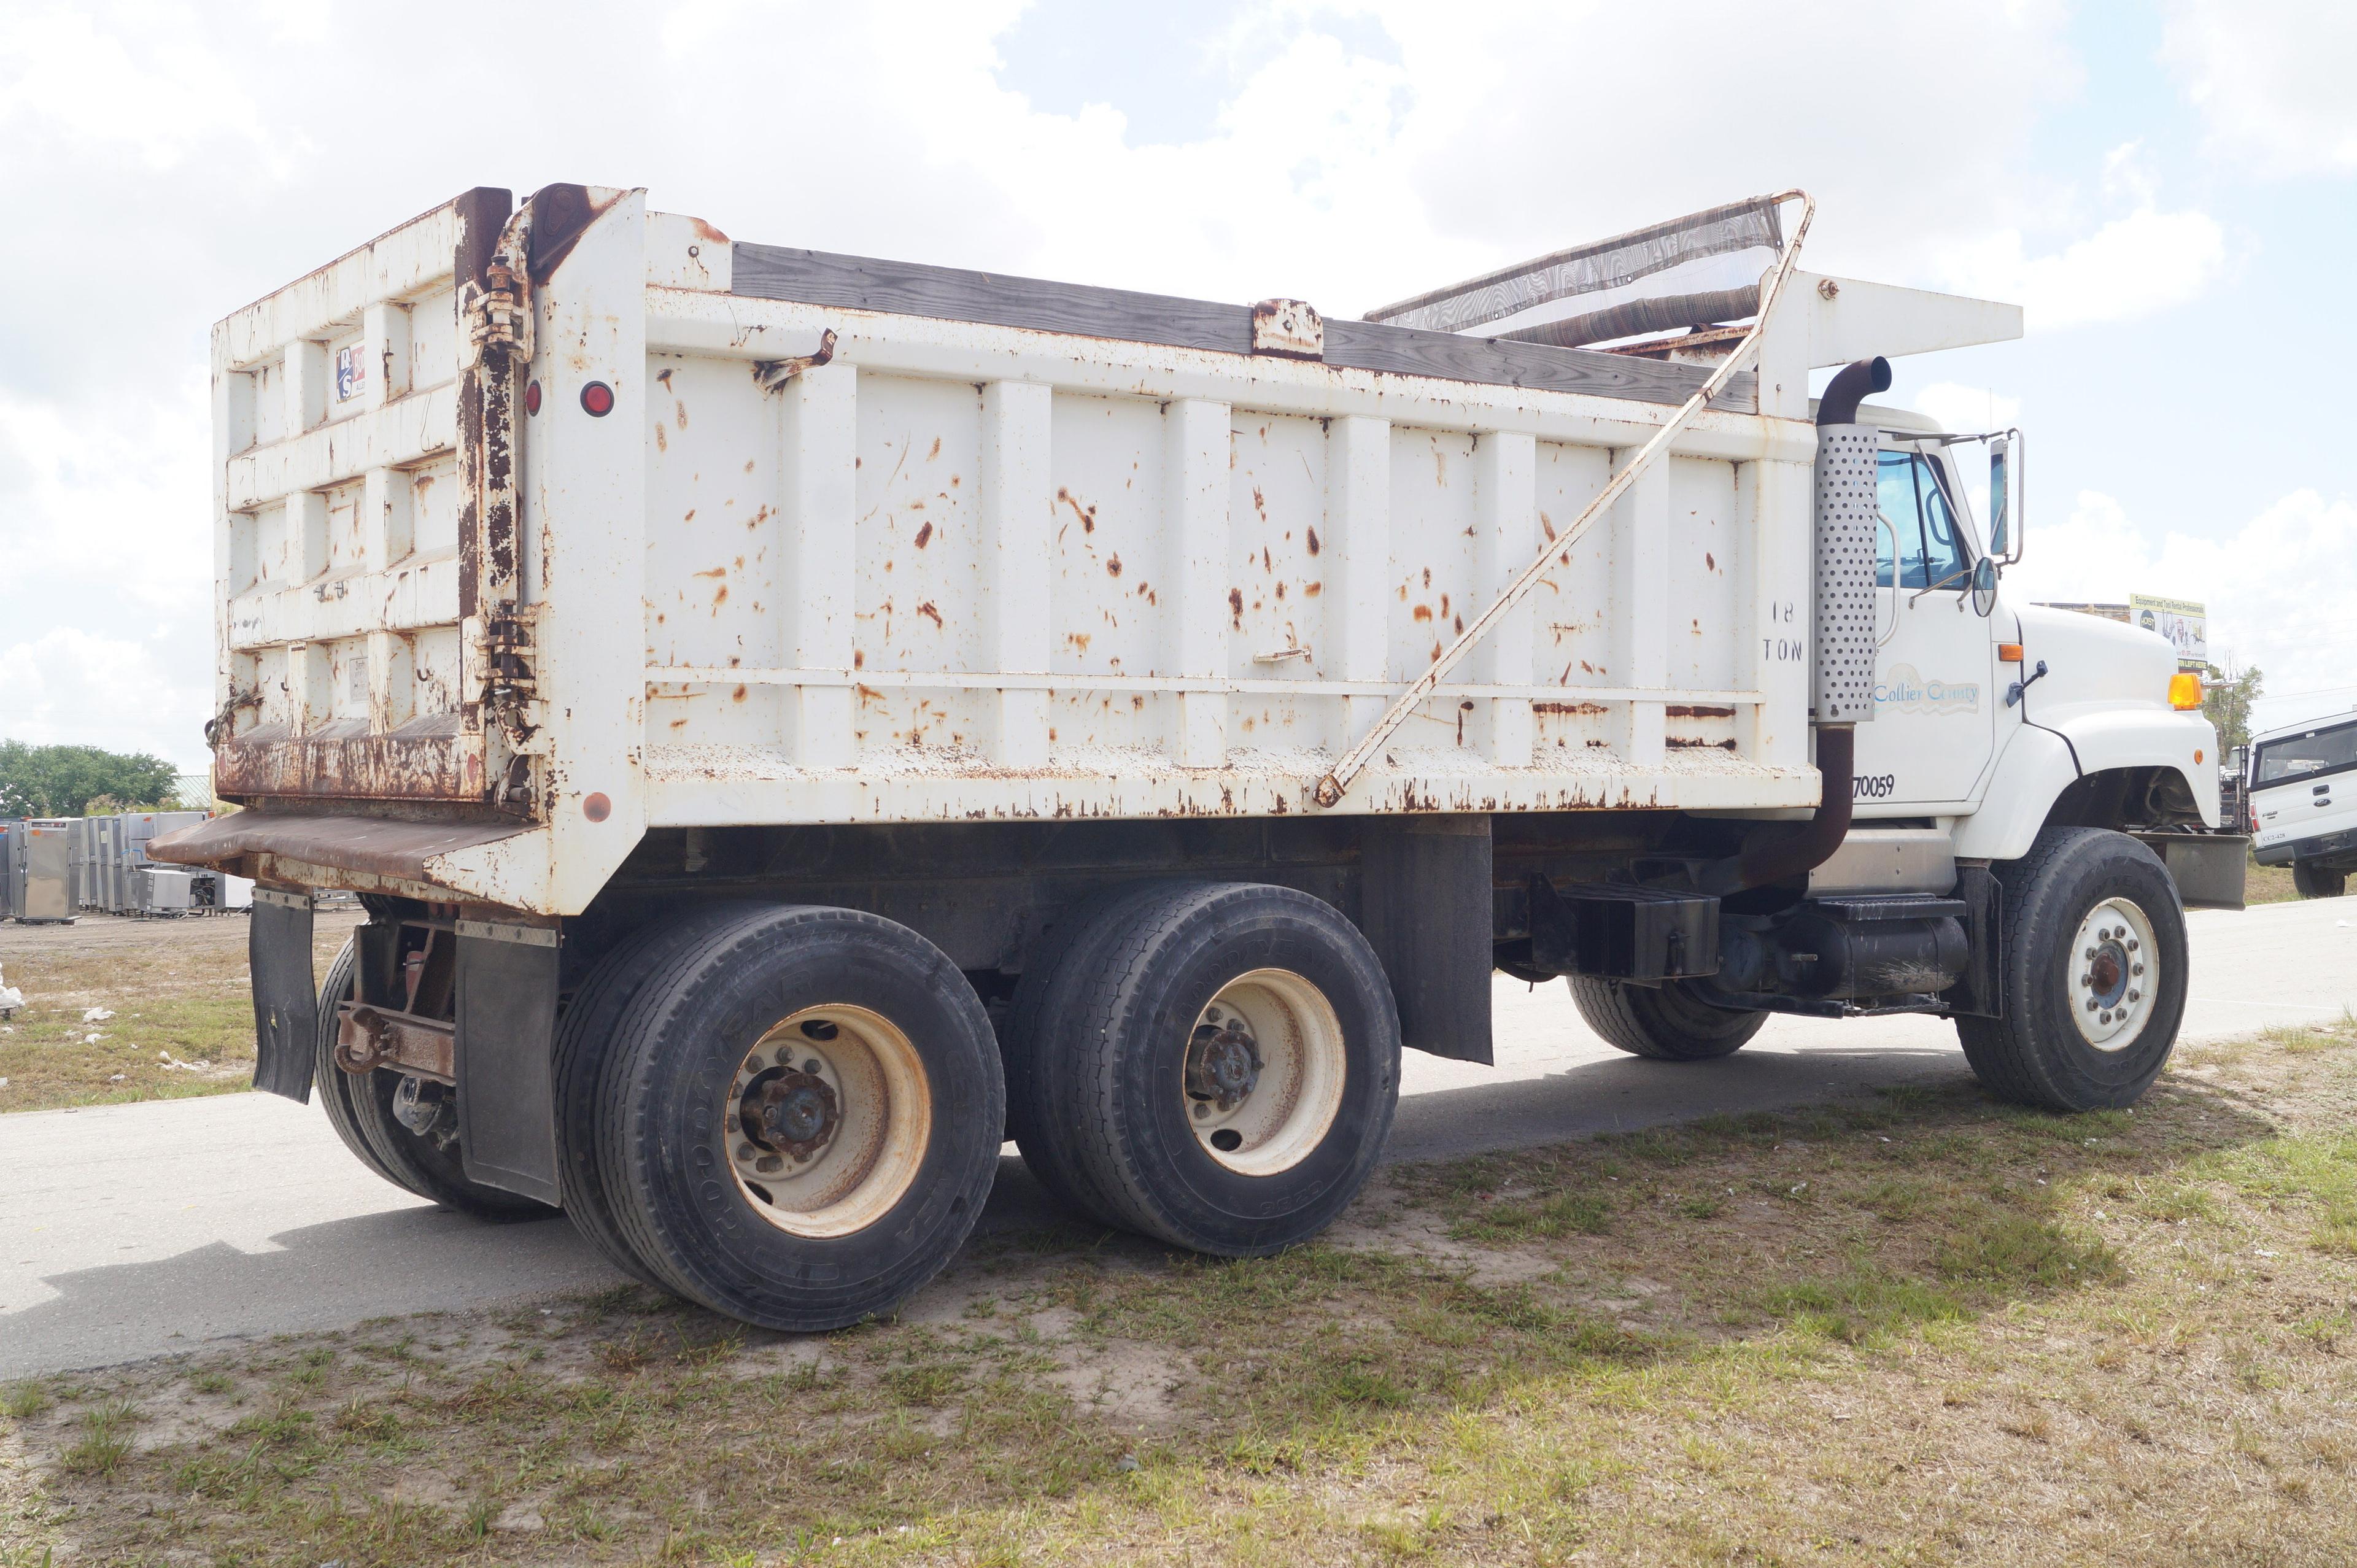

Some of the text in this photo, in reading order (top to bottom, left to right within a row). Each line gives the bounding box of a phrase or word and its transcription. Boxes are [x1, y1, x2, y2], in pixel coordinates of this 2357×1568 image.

[1773, 600, 1794, 624] 18
[2135, 595, 2156, 607] Equipment
[2172, 601, 2182, 611] Rental
[2182, 602, 2204, 614] Professionals
[1763, 638, 1802, 661] TON
[1874, 682, 1978, 703] Collier County
[1852, 774, 1895, 798] 70059
[2263, 833, 2286, 841] CC2-428
